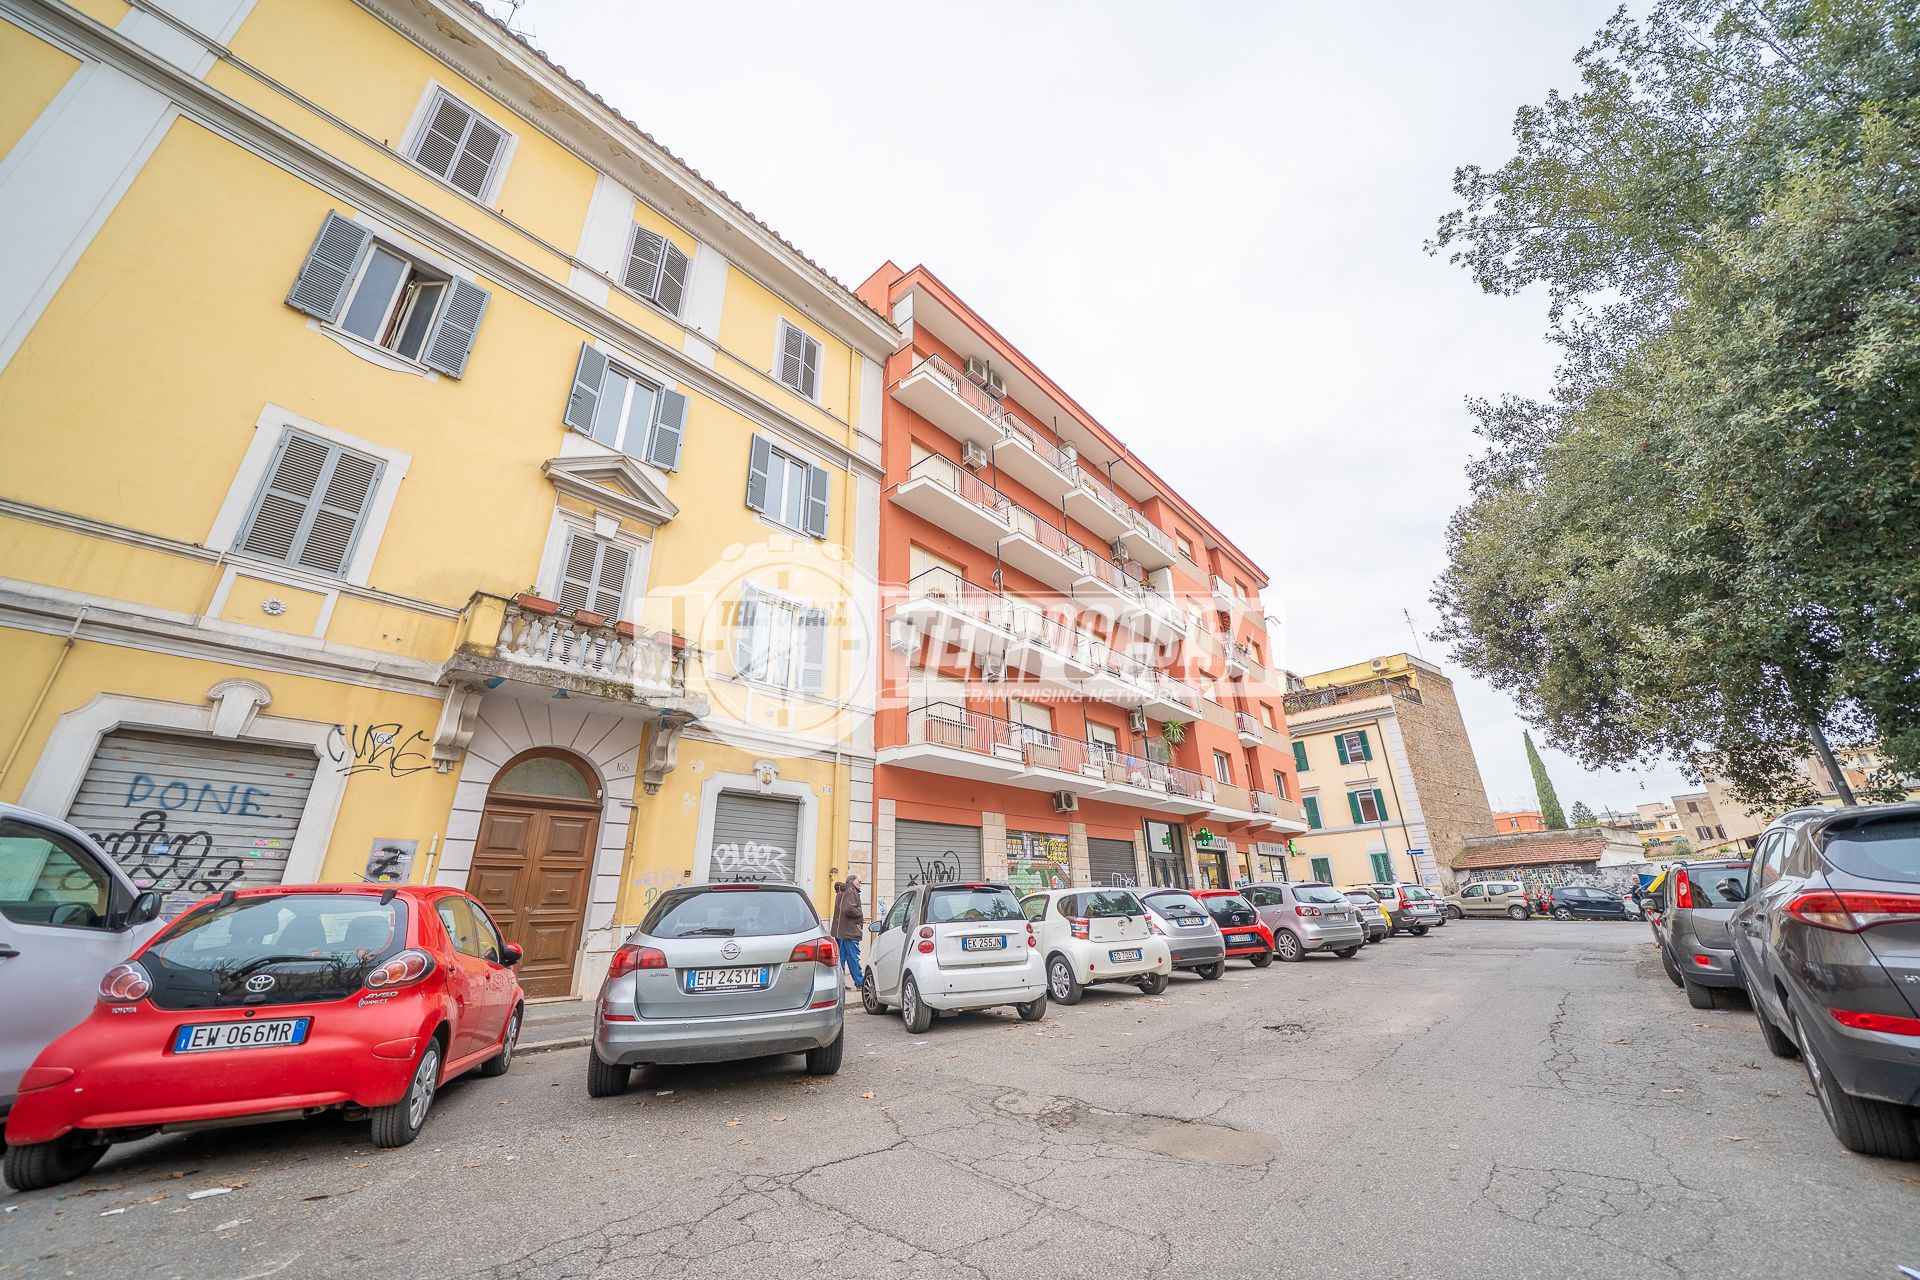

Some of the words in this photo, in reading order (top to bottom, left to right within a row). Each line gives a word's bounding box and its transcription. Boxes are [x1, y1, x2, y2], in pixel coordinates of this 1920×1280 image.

[968, 938, 977, 948] EK
[979, 937, 1002, 948] 255JN
[697, 971, 714, 986] EH
[718, 968, 759, 985] 243YM
[191, 1027, 219, 1048] EW
[226, 1023, 292, 1045] 066MR
